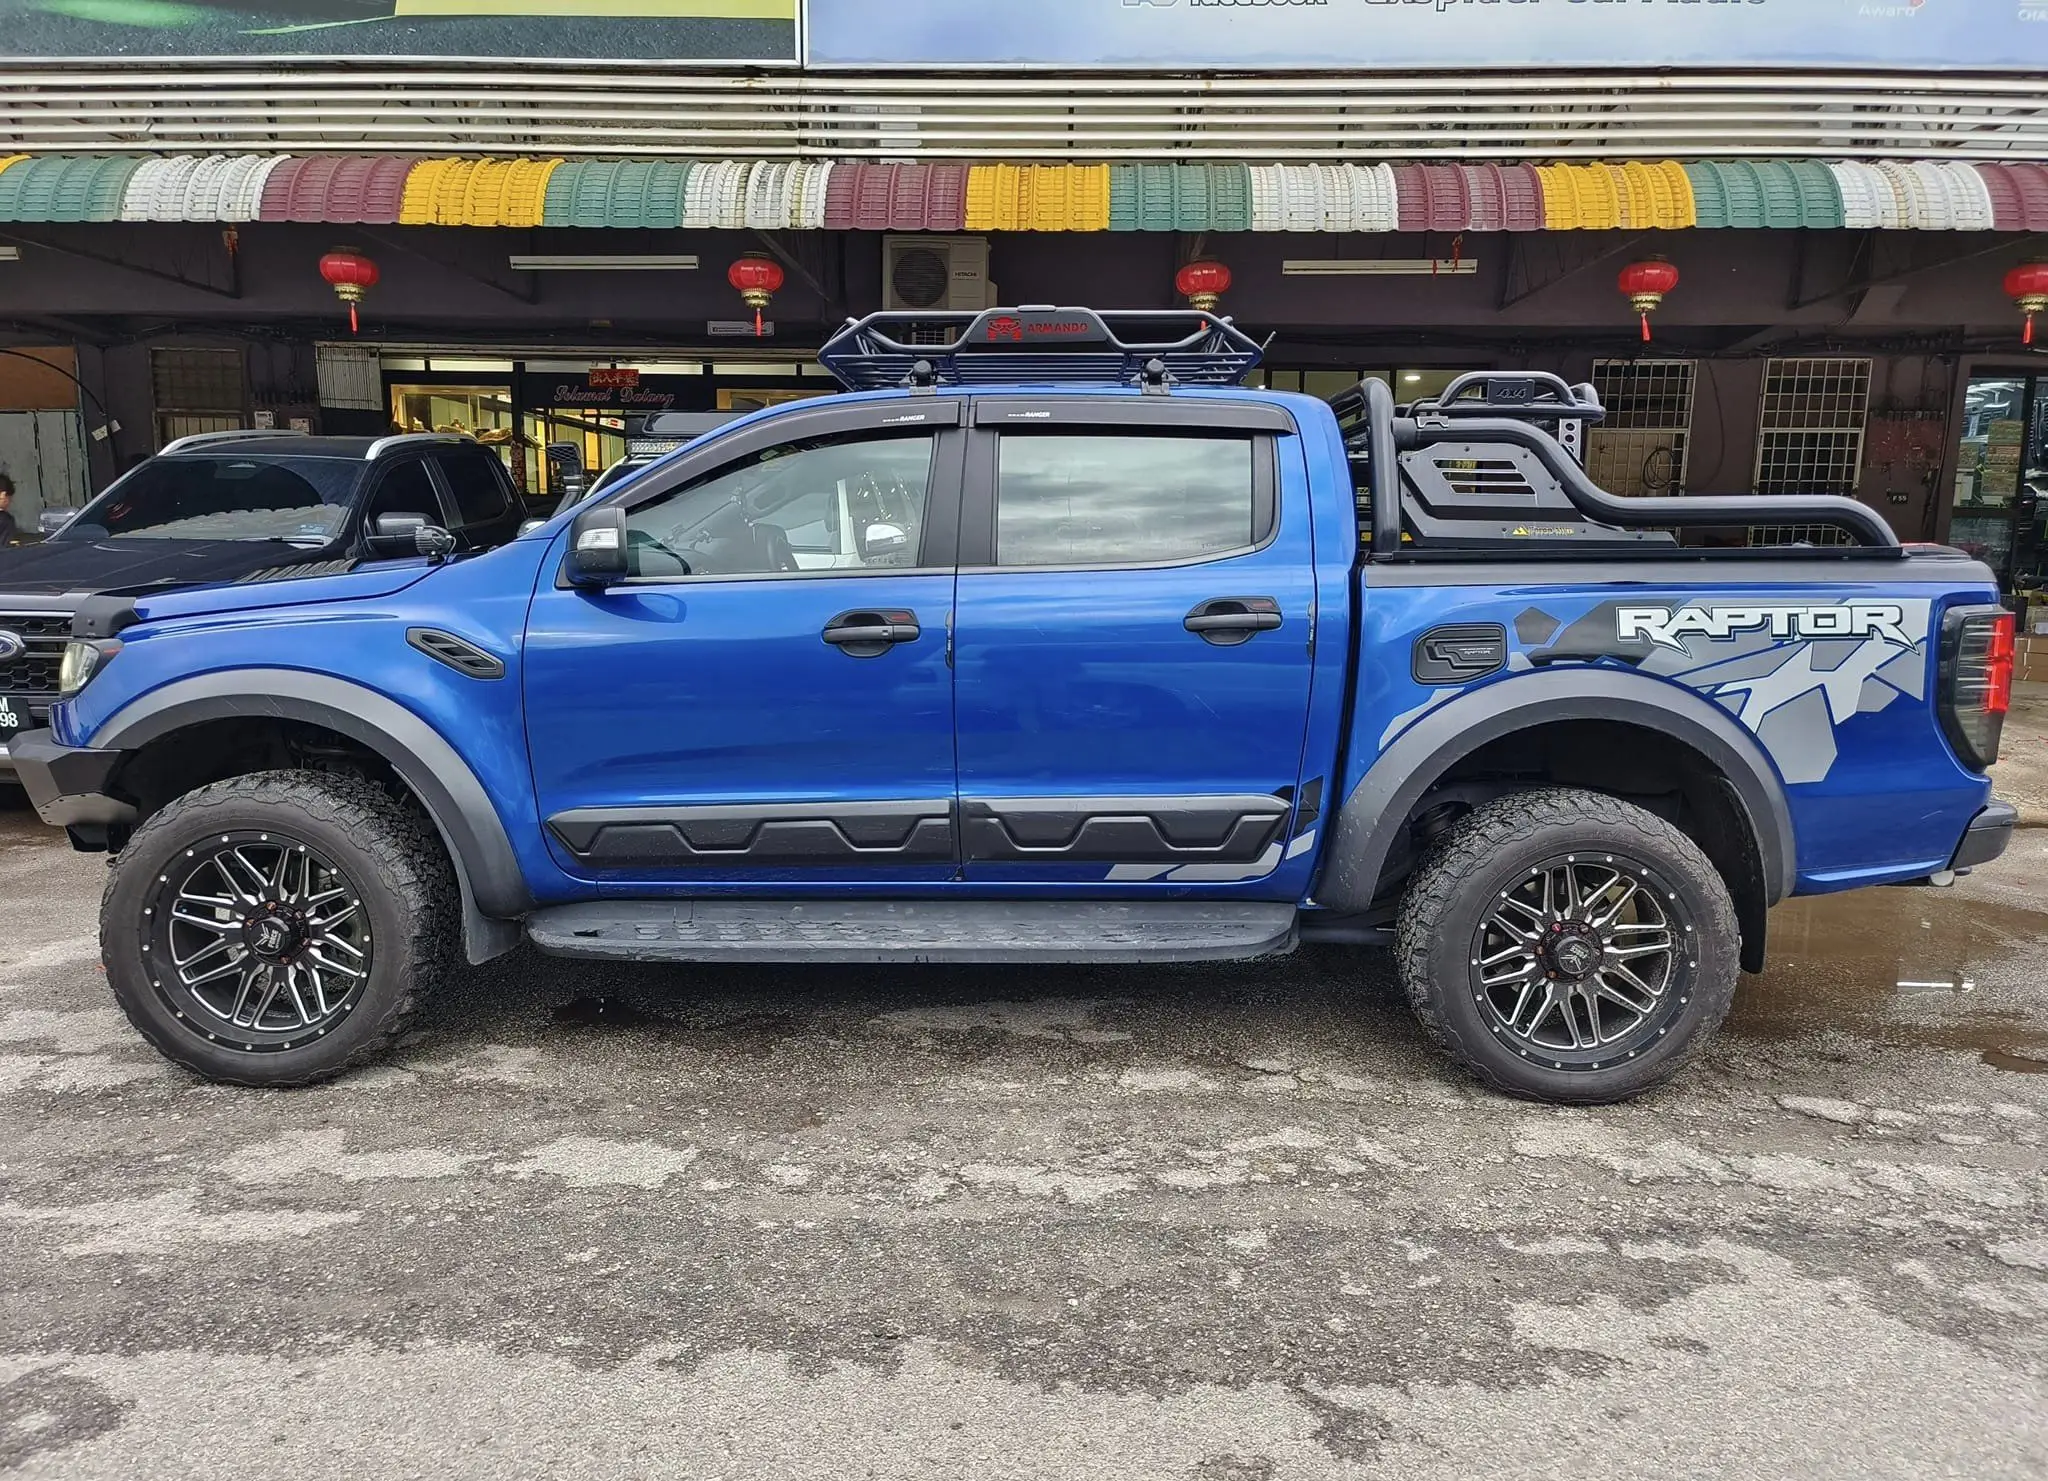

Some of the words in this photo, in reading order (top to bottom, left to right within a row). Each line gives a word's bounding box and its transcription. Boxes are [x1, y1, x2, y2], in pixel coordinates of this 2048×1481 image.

[1027, 322, 1088, 334] ARMANDO
[620, 386, 675, 408] Datang
[1616, 606, 1920, 659] RAPTOR
